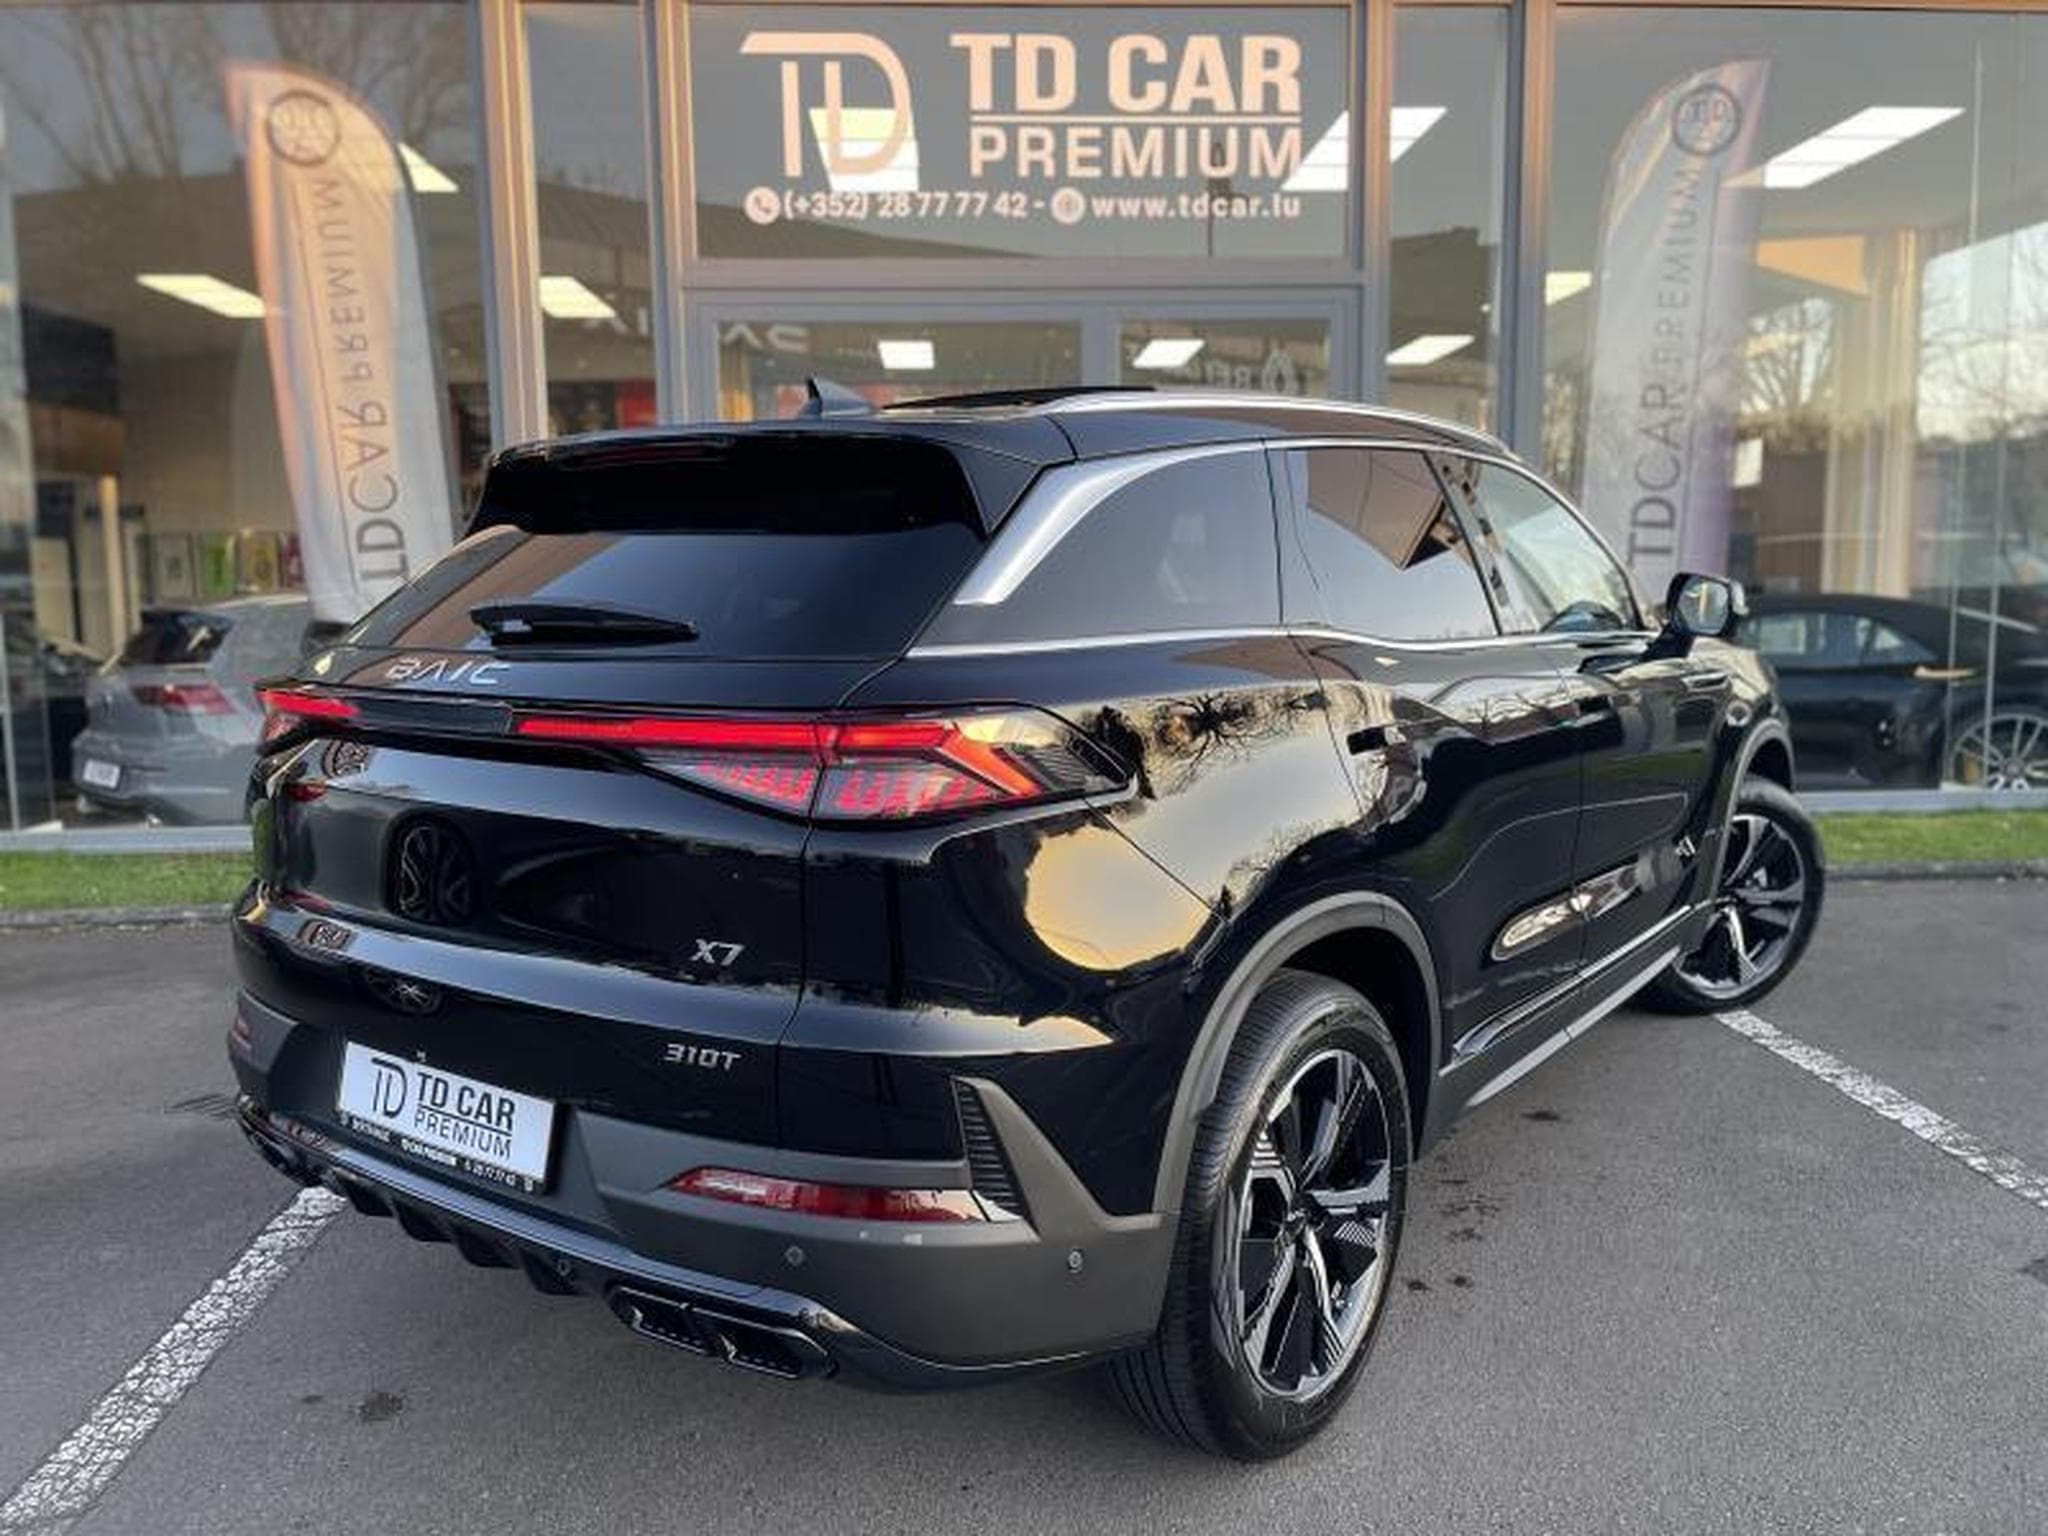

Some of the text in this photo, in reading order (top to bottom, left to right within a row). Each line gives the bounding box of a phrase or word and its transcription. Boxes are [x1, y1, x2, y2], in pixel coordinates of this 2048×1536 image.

[950, 33, 1302, 113] TD CAR
[970, 126, 1302, 178] PREMIUM
[878, 192, 910, 217] 28
[993, 192, 1028, 217] 42
[1091, 193, 1301, 218] www.tdcar.lu
[385, 658, 511, 685] BAIC
[690, 938, 745, 966] X7
[664, 1043, 742, 1071] 310T
[417, 1071, 516, 1132] TD CAR
[414, 1108, 512, 1161] PREMIUM
